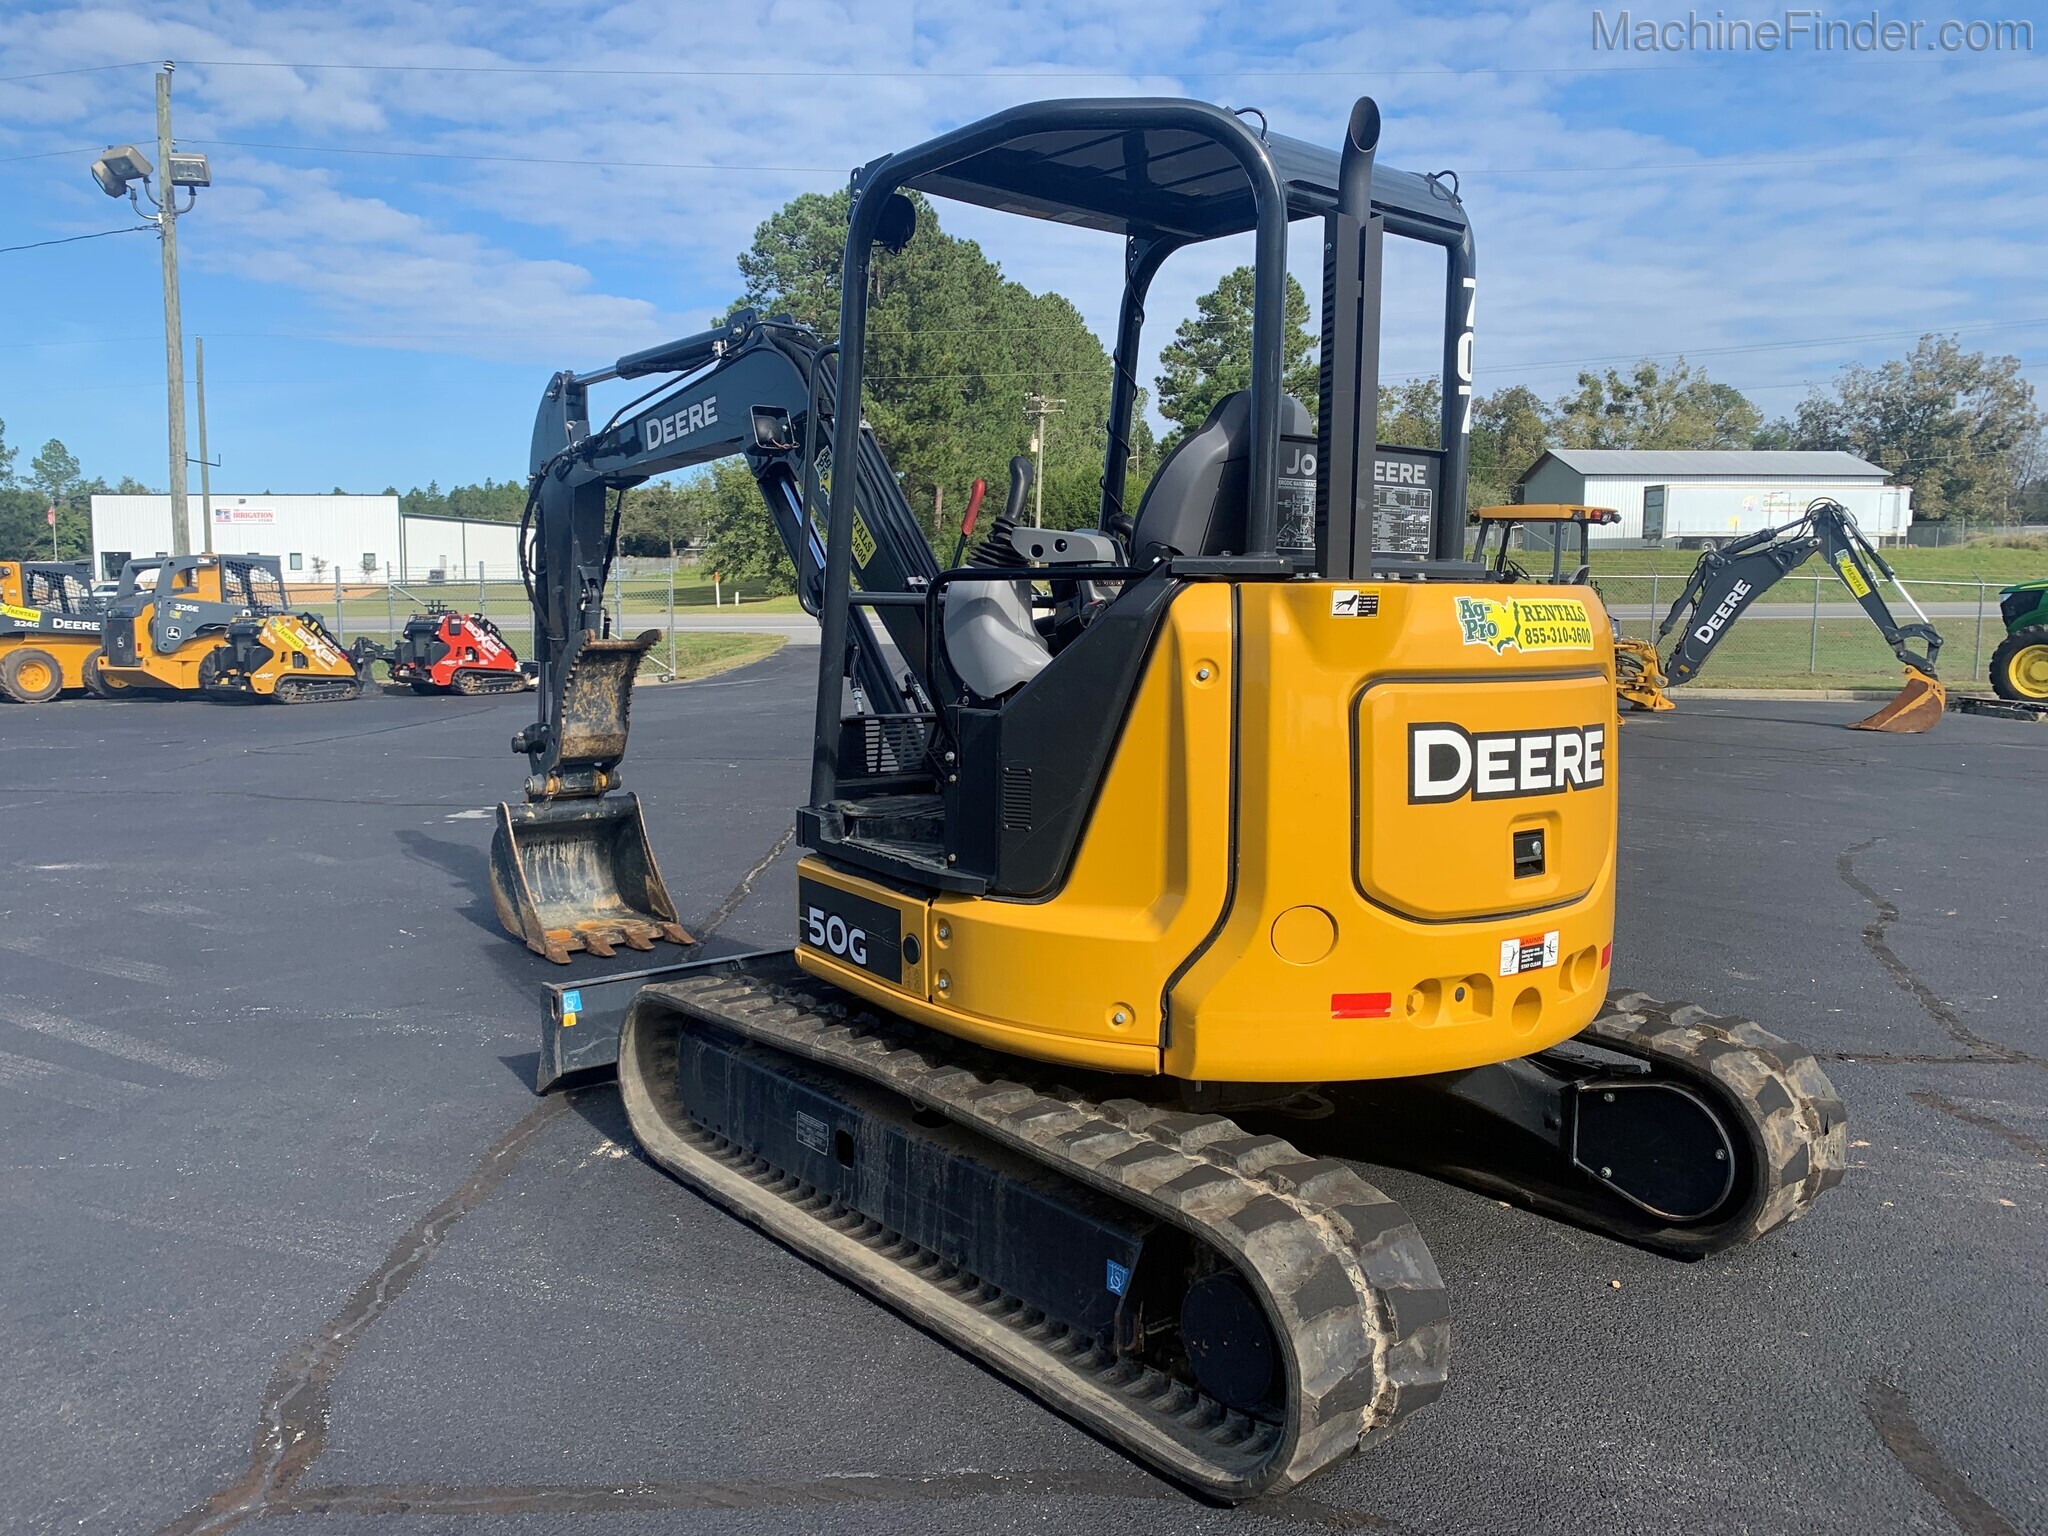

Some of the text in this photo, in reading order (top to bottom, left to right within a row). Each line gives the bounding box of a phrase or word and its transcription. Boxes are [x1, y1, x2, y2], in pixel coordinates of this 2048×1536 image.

[645, 395, 718, 451] DEERE
[1286, 449, 1427, 485] JO EERE
[1846, 567, 1866, 595] RENTALS
[10, 609, 39, 619] RENTALS
[174, 603, 199, 612] 326E
[1460, 600, 1491, 621] Ag-
[1520, 604, 1586, 622] RENTALS
[1693, 578, 1753, 645] DEERE
[13, 620, 40, 628] 324G
[53, 618, 100, 631] DEERE
[1465, 619, 1498, 641] Pro
[280, 630, 302, 649] RENTALS
[295, 627, 338, 666] BOXER
[464, 620, 501, 656] BOXER
[1525, 627, 1591, 645] 855-310-3600
[1414, 729, 1604, 797] DEERE
[809, 906, 867, 965] 50G
